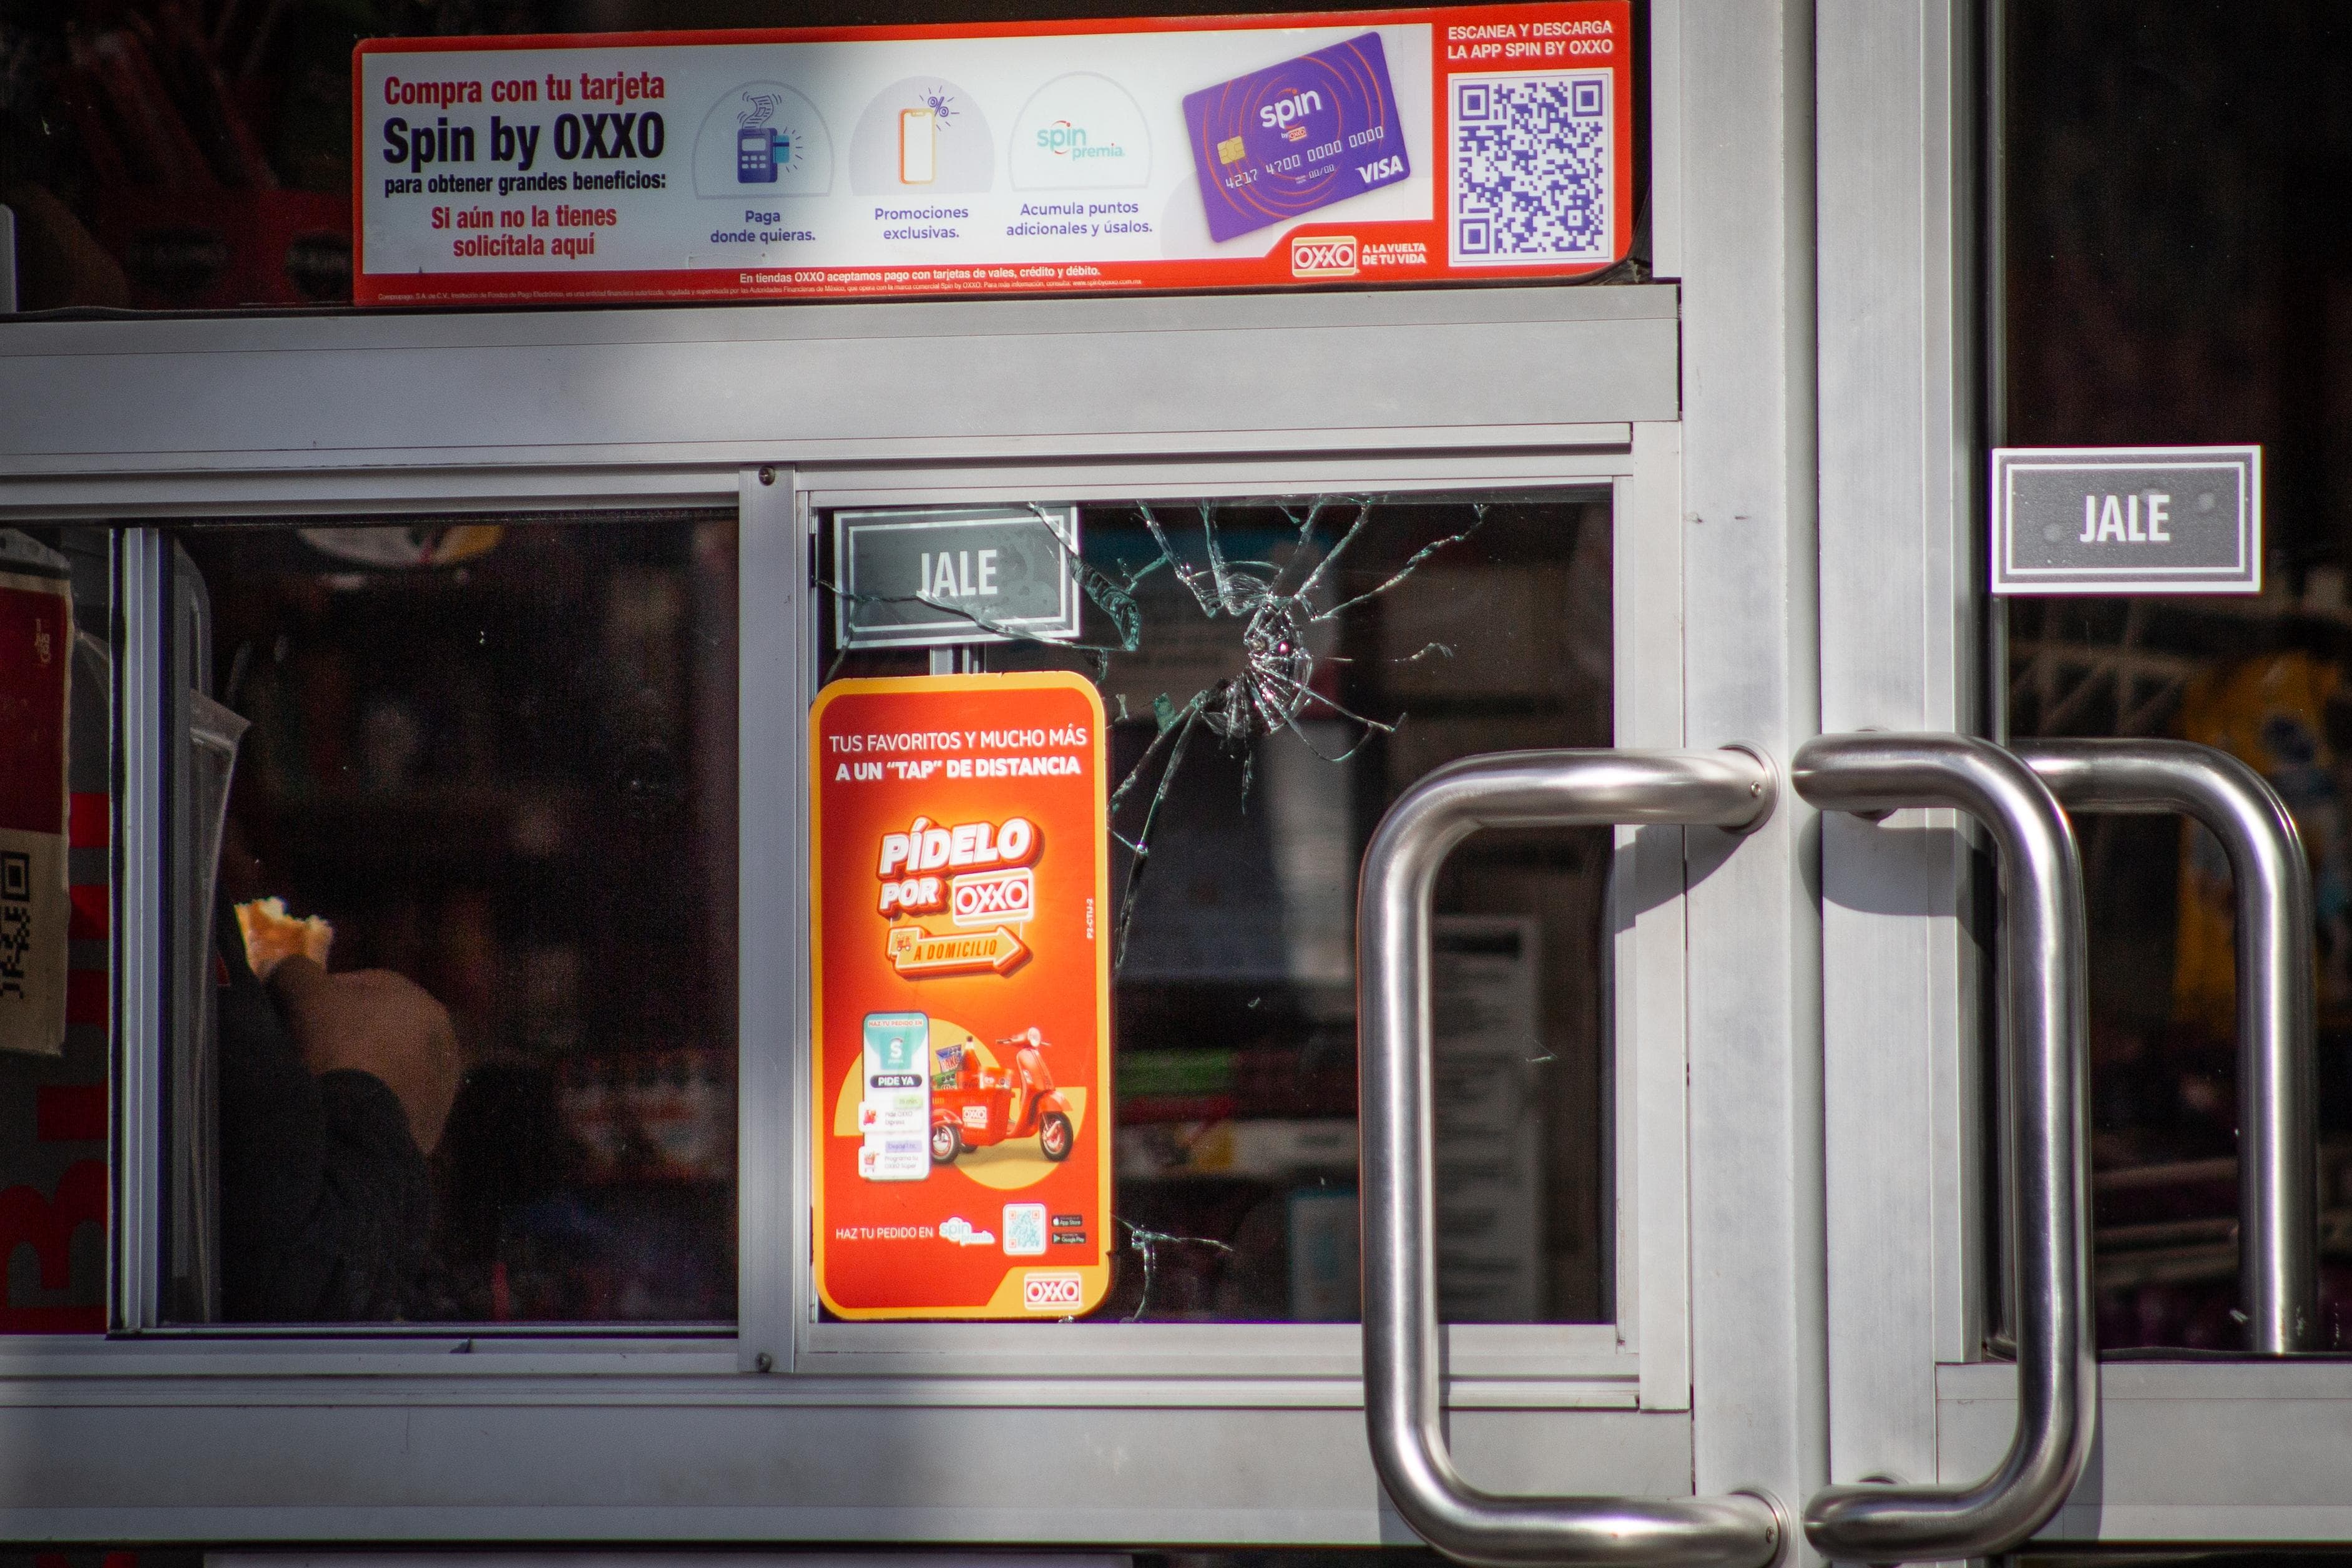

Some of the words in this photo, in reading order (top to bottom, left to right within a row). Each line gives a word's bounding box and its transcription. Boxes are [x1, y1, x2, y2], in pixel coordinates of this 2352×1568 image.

[1448, 24, 1517, 41] ESCANEA
[1518, 24, 1530, 37] Y
[1532, 21, 1613, 37] DESCARGA
[1448, 44, 1467, 59] LA
[1469, 43, 1502, 59] APP
[1505, 42, 1541, 57] SPIN
[1544, 41, 1567, 56] BY
[1569, 38, 1613, 54] OXXO
[384, 76, 482, 109] Compra
[491, 78, 537, 103] con
[546, 73, 571, 100] tu
[579, 71, 665, 105] tarjeta
[1260, 89, 1322, 129] spin
[383, 117, 474, 173] Spin
[491, 115, 541, 171] by
[553, 111, 665, 160] OXXO
[1037, 122, 1086, 151] spin
[1289, 128, 1306, 140] OXXO
[1072, 143, 1125, 162] premia
[1225, 169, 1258, 189] 4217
[1266, 154, 1301, 175] 4700
[1306, 140, 1343, 162] 0000
[1348, 125, 1384, 149] 0000
[1308, 164, 1335, 179] 00/00
[1355, 155, 1404, 184] VISA
[384, 177, 423, 198] para
[428, 174, 492, 194] obtener
[498, 172, 567, 196] grandes
[572, 170, 667, 191] beneficios:
[431, 206, 450, 230] Si
[456, 205, 493, 228] aún
[500, 208, 525, 228] no
[531, 205, 549, 227] la
[556, 204, 617, 227] tienes
[744, 210, 781, 226] Paga
[875, 205, 969, 222] Promociones
[1020, 202, 1085, 216] Acumula
[1088, 200, 1139, 218] puntos
[710, 229, 755, 244] donde
[760, 228, 816, 245] quieras.
[883, 225, 960, 240] exclusivas.
[1006, 221, 1088, 237] adicionales
[1091, 224, 1099, 237] y
[1104, 220, 1153, 235] úsalos.
[453, 233, 544, 258] solicítala
[551, 232, 595, 260] aquí
[1295, 243, 1354, 270] OXXO
[1362, 244, 1372, 253] A
[1373, 243, 1387, 253] LA
[1387, 242, 1426, 252] VUELTA
[1362, 254, 1378, 265] DE
[1378, 253, 1395, 265] TU
[1395, 253, 1426, 264] VIDA
[740, 273, 753, 283] En
[756, 272, 791, 283] tiendas
[795, 271, 825, 282] OXXO
[827, 271, 881, 283] aceptamos
[884, 272, 909, 282] pago
[911, 271, 930, 280] con
[933, 268, 971, 281] tarjetas
[973, 268, 986, 278] de
[987, 267, 1017, 279] vales,
[1019, 265, 1055, 277] crédito
[1057, 268, 1064, 278] y
[1066, 265, 1100, 277] débito.
[2079, 494, 2170, 542] JALE
[916, 549, 998, 597] JALE
[829, 735, 863, 753] TUS
[868, 732, 960, 751] FAVORITOS
[965, 731, 976, 748] Y
[981, 728, 1045, 748] MUCHO
[1049, 723, 1087, 746] MÁS
[835, 763, 850, 782] A
[853, 762, 883, 780] UN
[946, 758, 974, 778] DE
[976, 755, 1081, 777] DISTANCIA
[880, 816, 1032, 875] PÍDELO
[881, 878, 939, 909] POR
[955, 878, 1029, 914] OXXO
[913, 948, 922, 961] A
[927, 939, 997, 960] DOMICILIO
[878, 1077, 899, 1086] PIDE
[901, 1076, 914, 1085] YA
[963, 1109, 986, 1120] OXXO
[835, 1228, 858, 1239] HAZ
[860, 1227, 874, 1239] TU
[876, 1227, 917, 1239] PEDIDO
[919, 1226, 933, 1238] EN
[1026, 1279, 1080, 1303] OXXO
